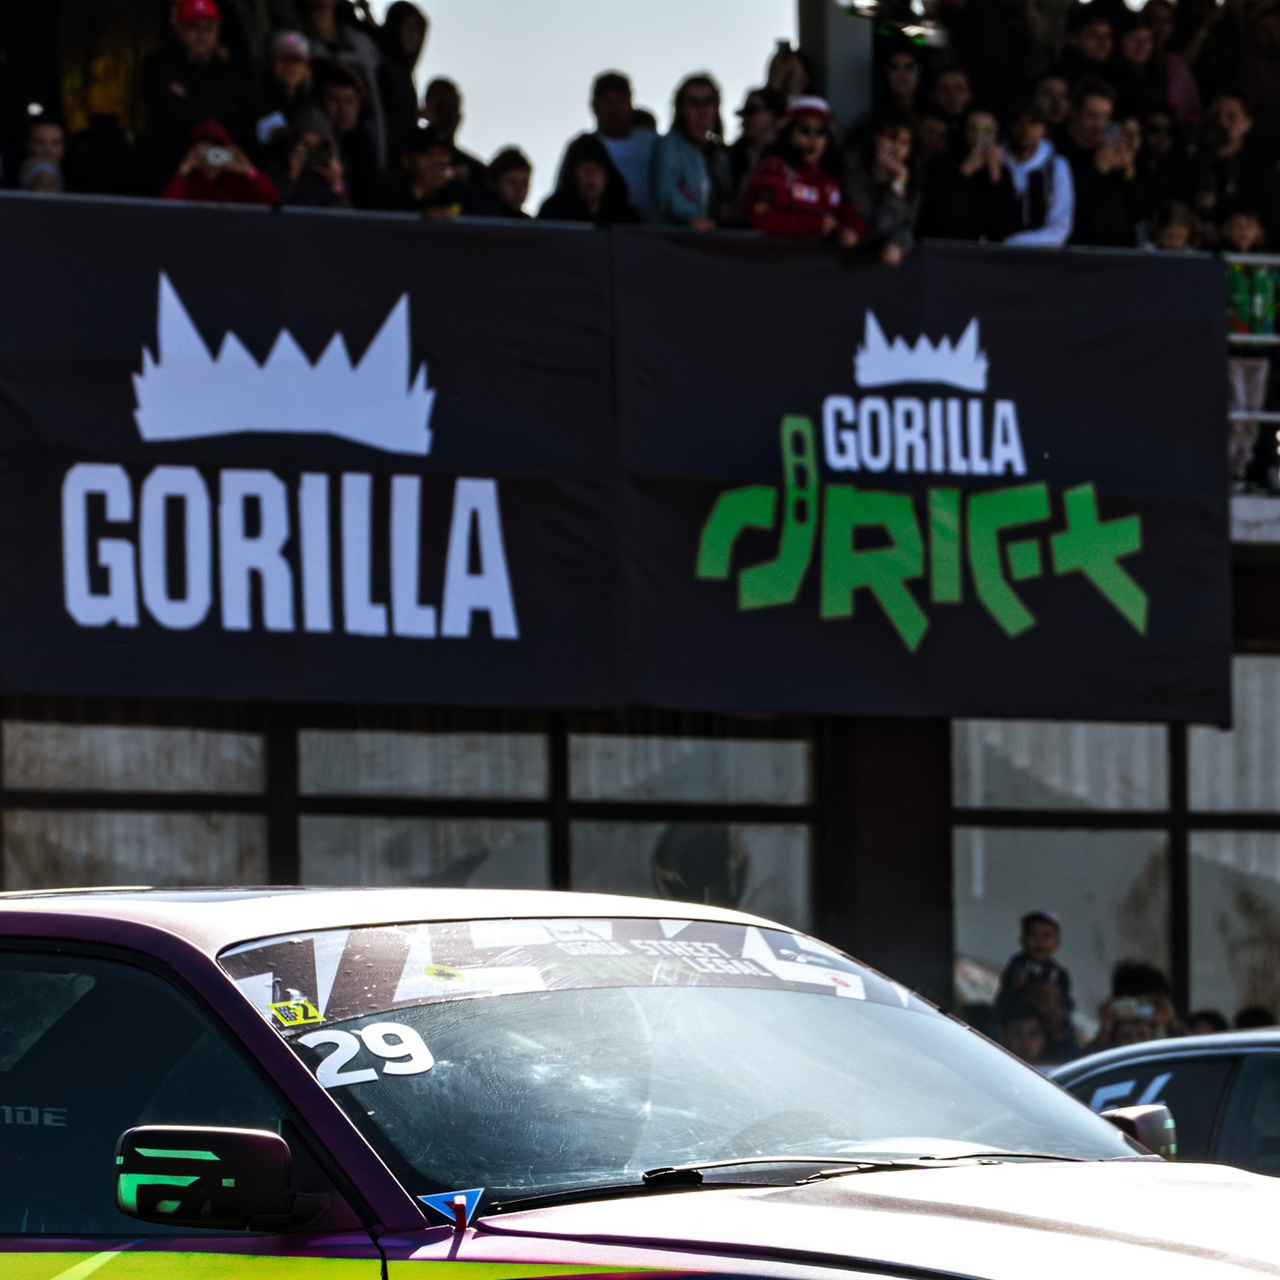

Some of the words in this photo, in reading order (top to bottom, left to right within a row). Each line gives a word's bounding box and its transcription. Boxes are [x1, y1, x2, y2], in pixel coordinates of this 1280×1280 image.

[823, 395, 1026, 475] GORILLA
[61, 463, 519, 639] GORILLA
[628, 938, 734, 959] STREET
[680, 955, 774, 978] LEGAL
[297, 1021, 435, 1089] 29
